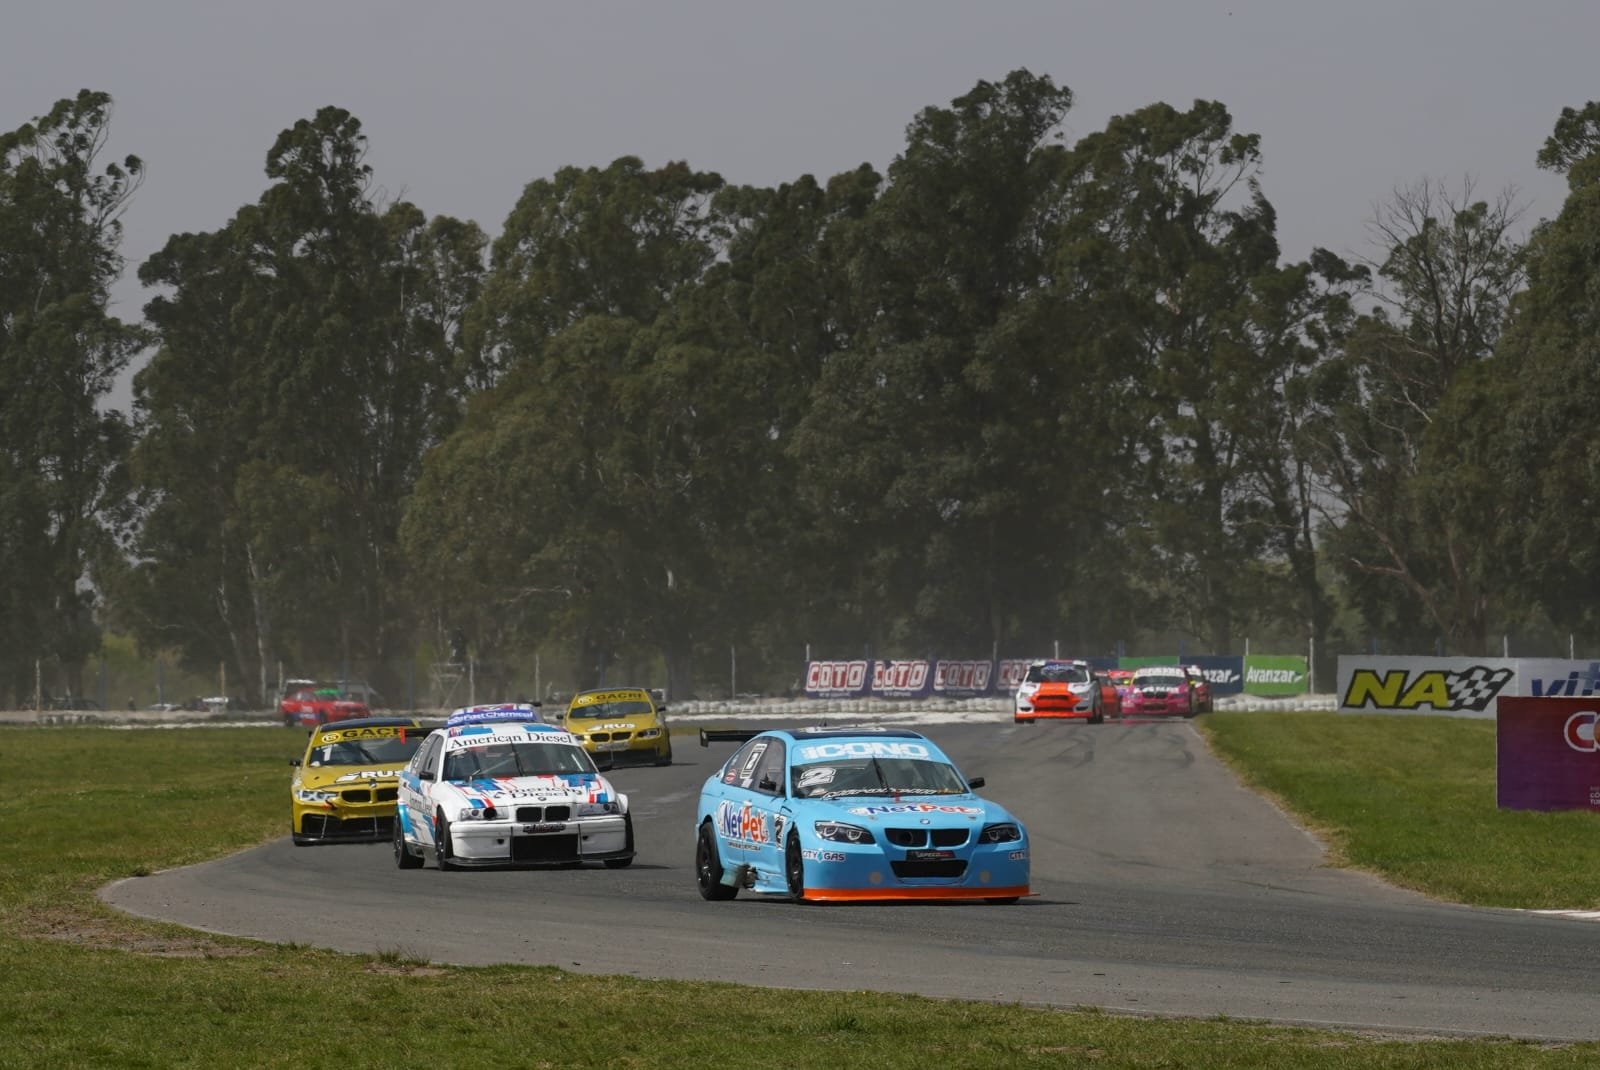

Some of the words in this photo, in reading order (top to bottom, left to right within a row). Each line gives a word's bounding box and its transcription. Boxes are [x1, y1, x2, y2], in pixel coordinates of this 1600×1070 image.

[806, 661, 867, 691] COTO
[872, 661, 929, 690] COTO
[934, 660, 991, 690] COTO
[1247, 666, 1294, 683] Avanzar
[451, 734, 521, 748] American
[527, 732, 572, 743] Diesel
[798, 767, 836, 788] 2
[866, 803, 972, 814] NetPet
[723, 804, 766, 842] NetPet
[823, 852, 845, 861] GAS
